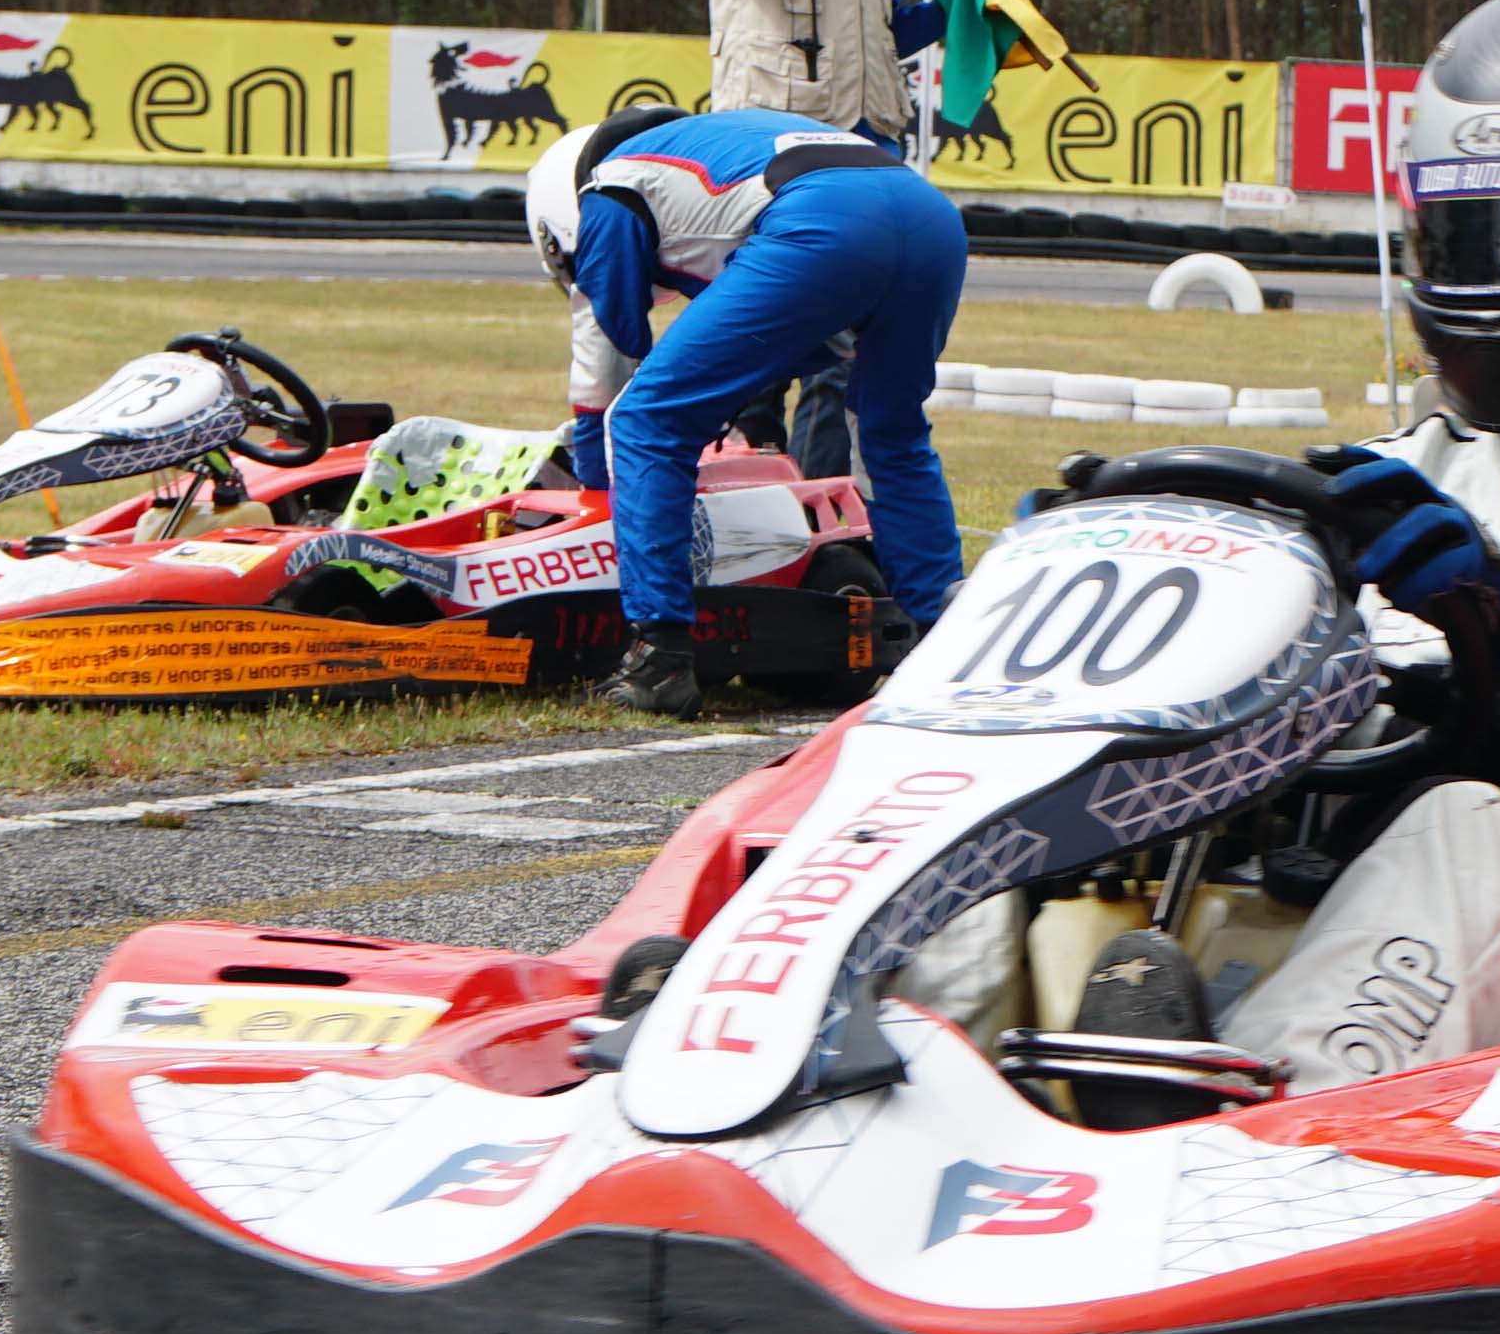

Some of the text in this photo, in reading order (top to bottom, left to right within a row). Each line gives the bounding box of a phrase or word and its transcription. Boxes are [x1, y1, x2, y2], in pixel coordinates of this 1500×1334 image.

[130, 35, 356, 158] eni
[1046, 70, 1245, 185] eni
[466, 540, 618, 601] FERBER
[949, 560, 1200, 687] 100
[677, 770, 974, 1056] FERBERTO
[253, 1002, 417, 1047] eni
[1320, 935, 1457, 1078] OMP
